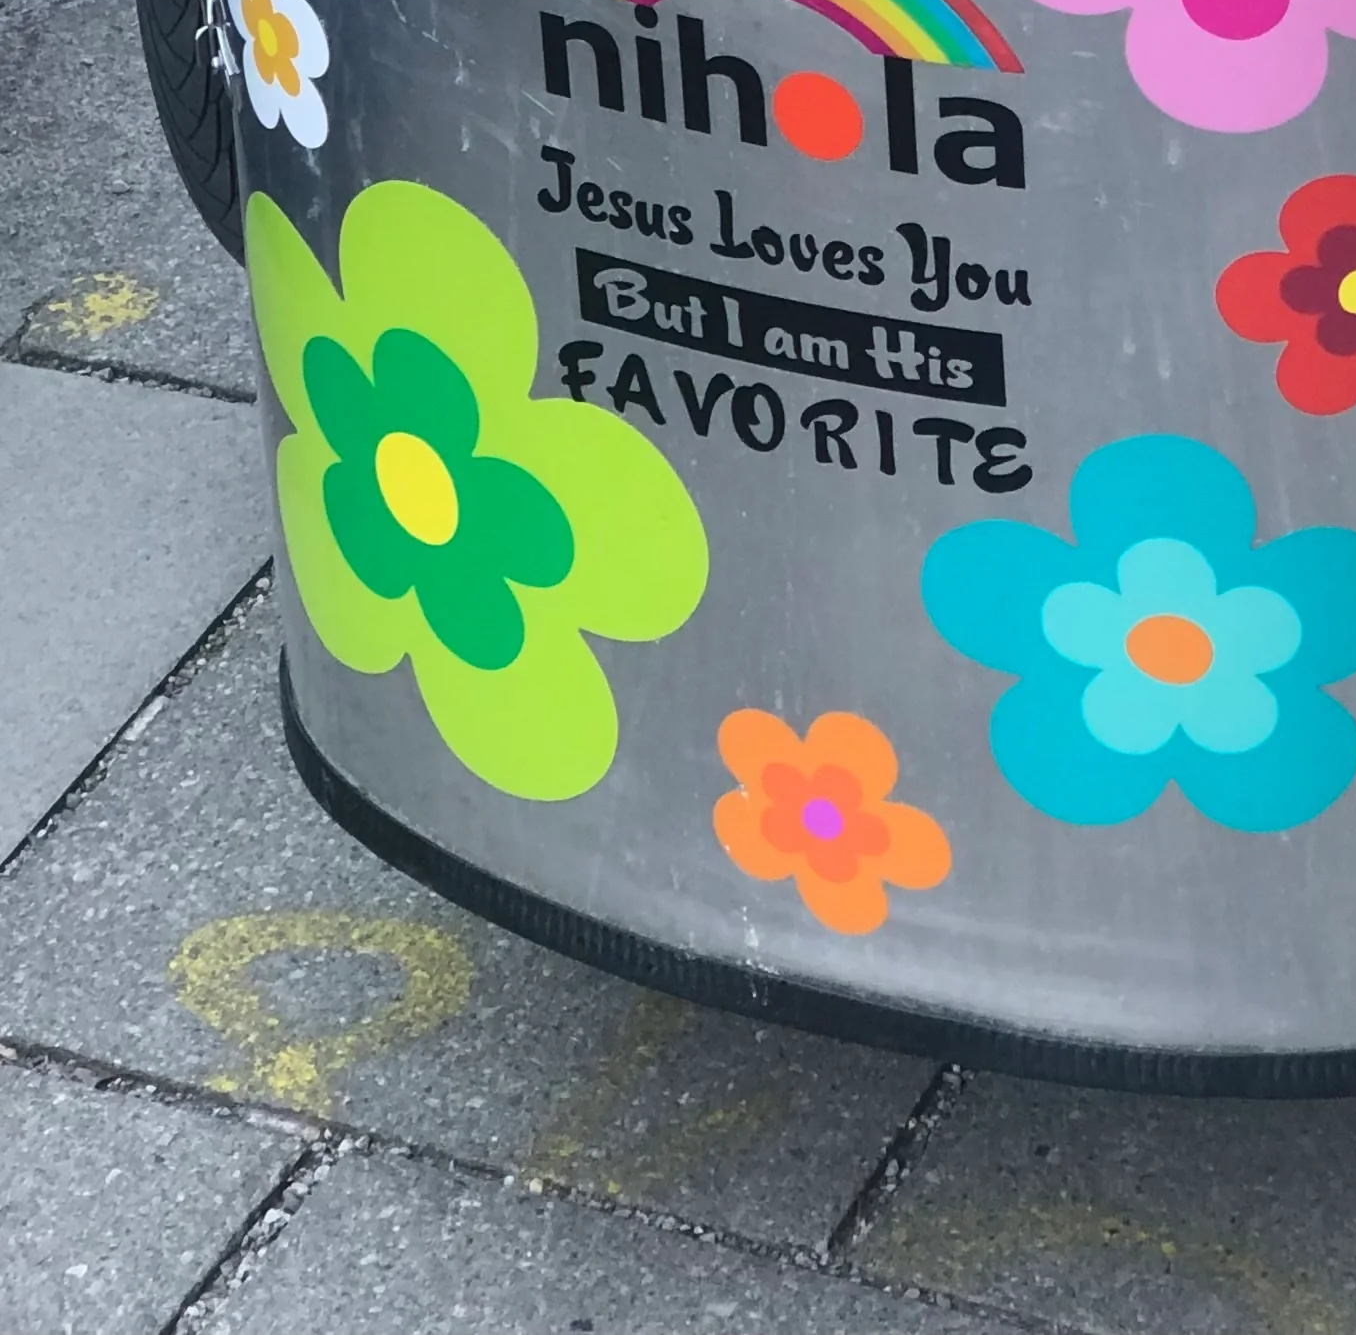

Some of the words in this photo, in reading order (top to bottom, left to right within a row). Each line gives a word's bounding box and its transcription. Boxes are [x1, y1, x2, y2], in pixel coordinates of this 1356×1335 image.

[537, 144, 694, 246] Jesus
[709, 188, 886, 287] Loves
[895, 222, 1032, 313] You
[593, 267, 708, 339] But
[723, 296, 742, 347] I
[763, 326, 851, 371] am
[864, 330, 975, 390] His
[557, 339, 1034, 495] FAVORITE
